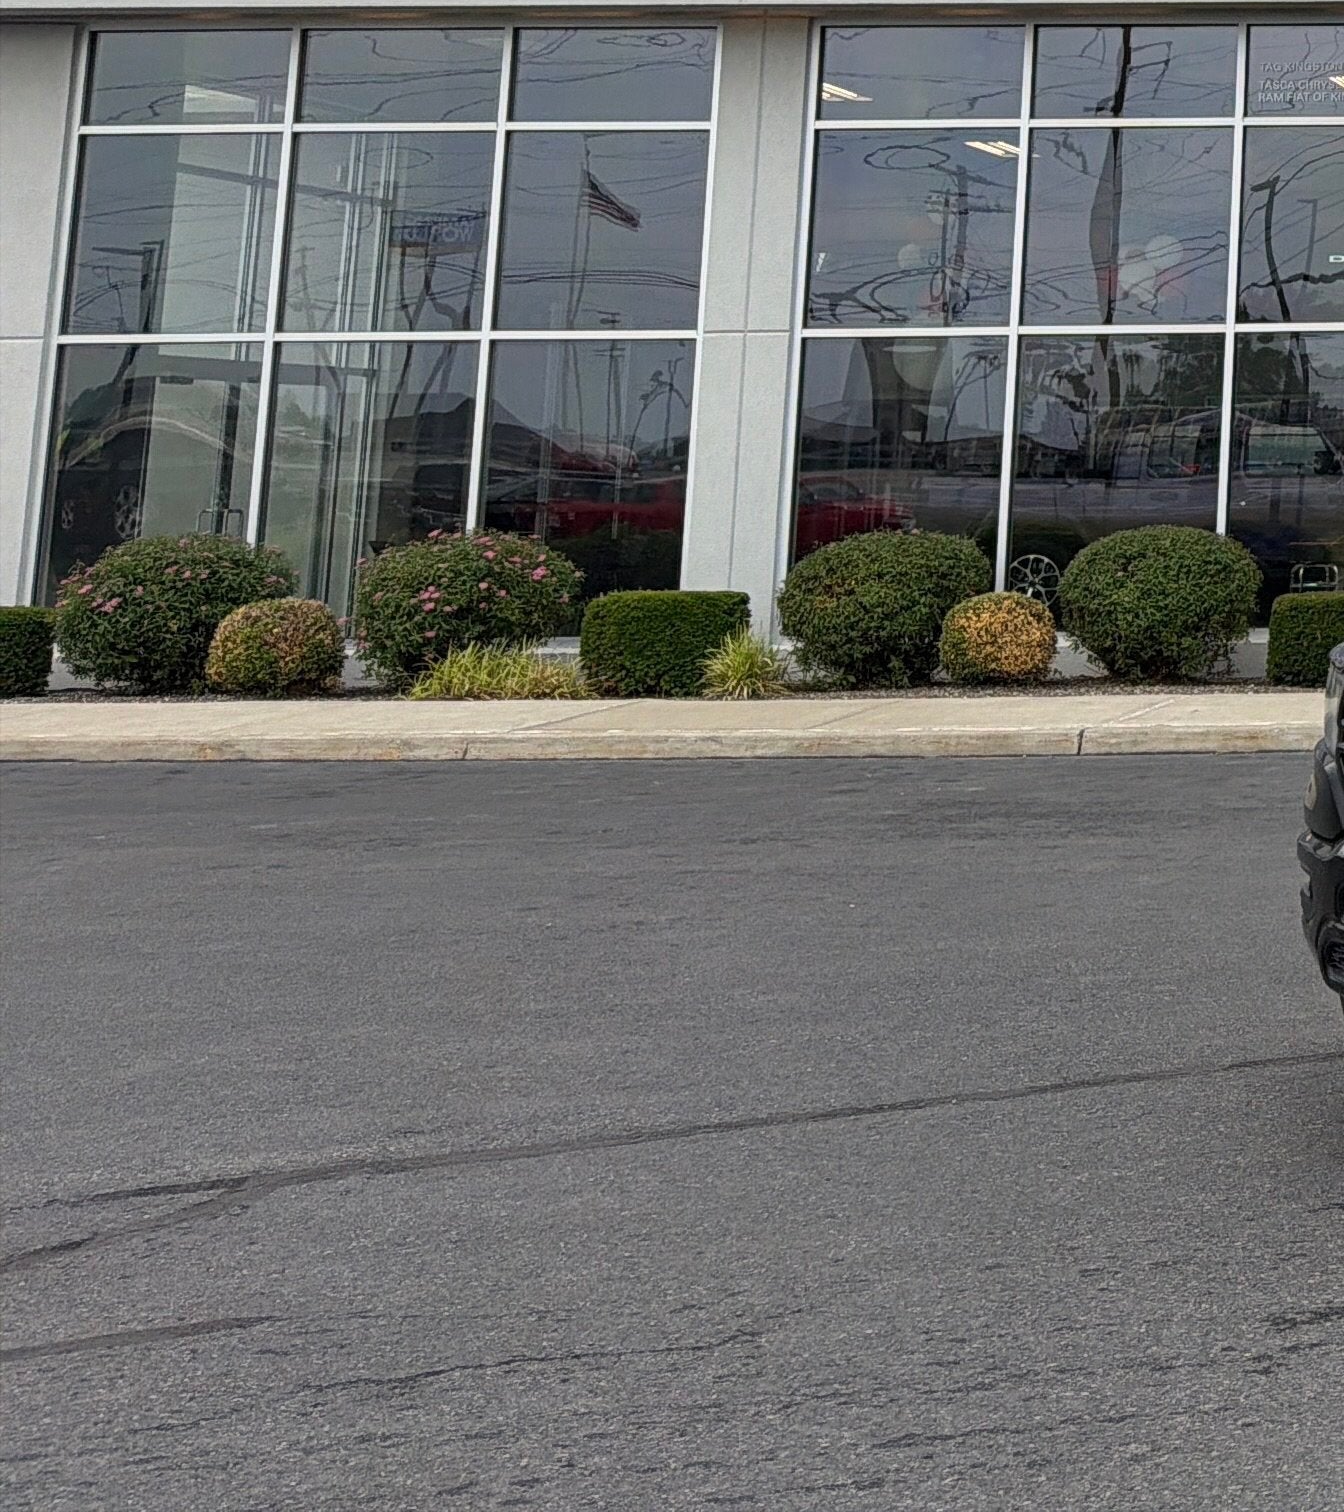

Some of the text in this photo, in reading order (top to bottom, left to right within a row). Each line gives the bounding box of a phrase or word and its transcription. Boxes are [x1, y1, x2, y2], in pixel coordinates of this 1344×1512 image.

[1259, 79, 1297, 90] TASCA
[1258, 91, 1284, 103] RAM
[1286, 91, 1311, 103] FIAT
[1312, 91, 1328, 102] OF
